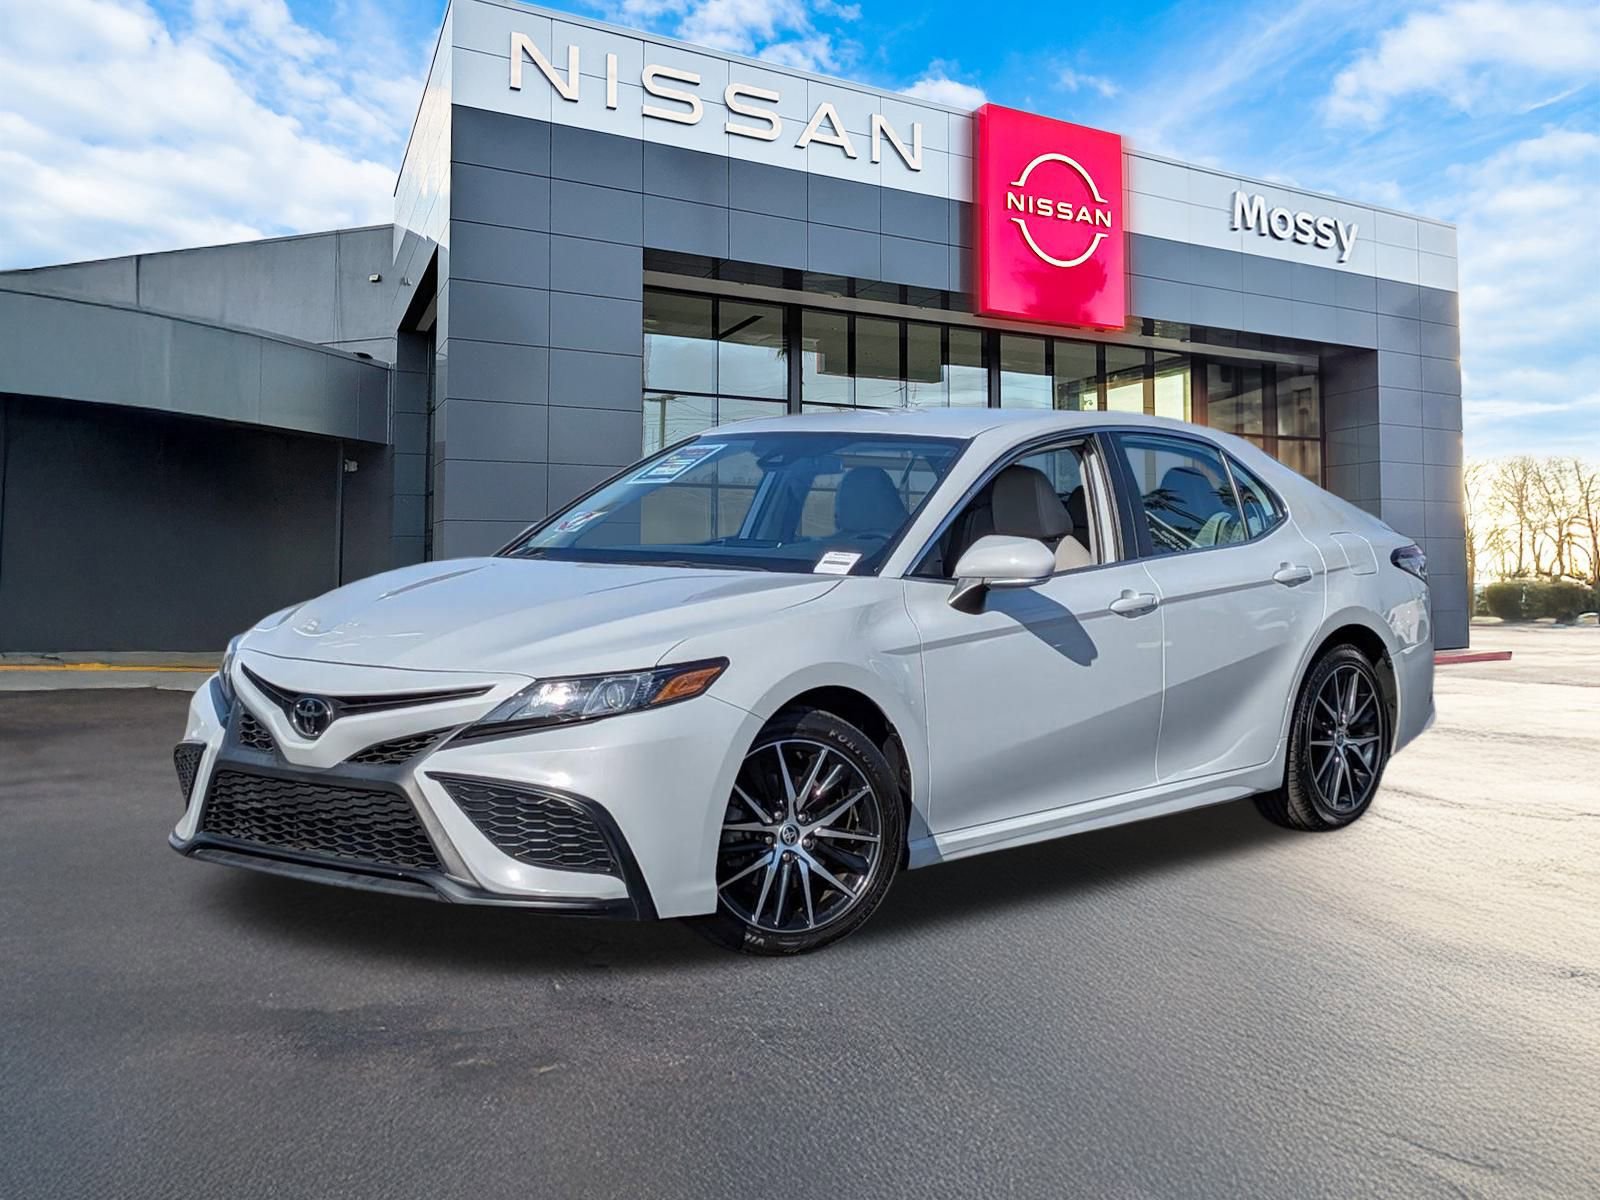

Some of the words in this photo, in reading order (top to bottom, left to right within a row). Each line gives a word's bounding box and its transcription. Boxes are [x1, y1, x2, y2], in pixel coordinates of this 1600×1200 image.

[509, 31, 923, 172] NISSAN
[1006, 191, 1112, 228] NISSAN
[1230, 190, 1359, 262] Mossy
